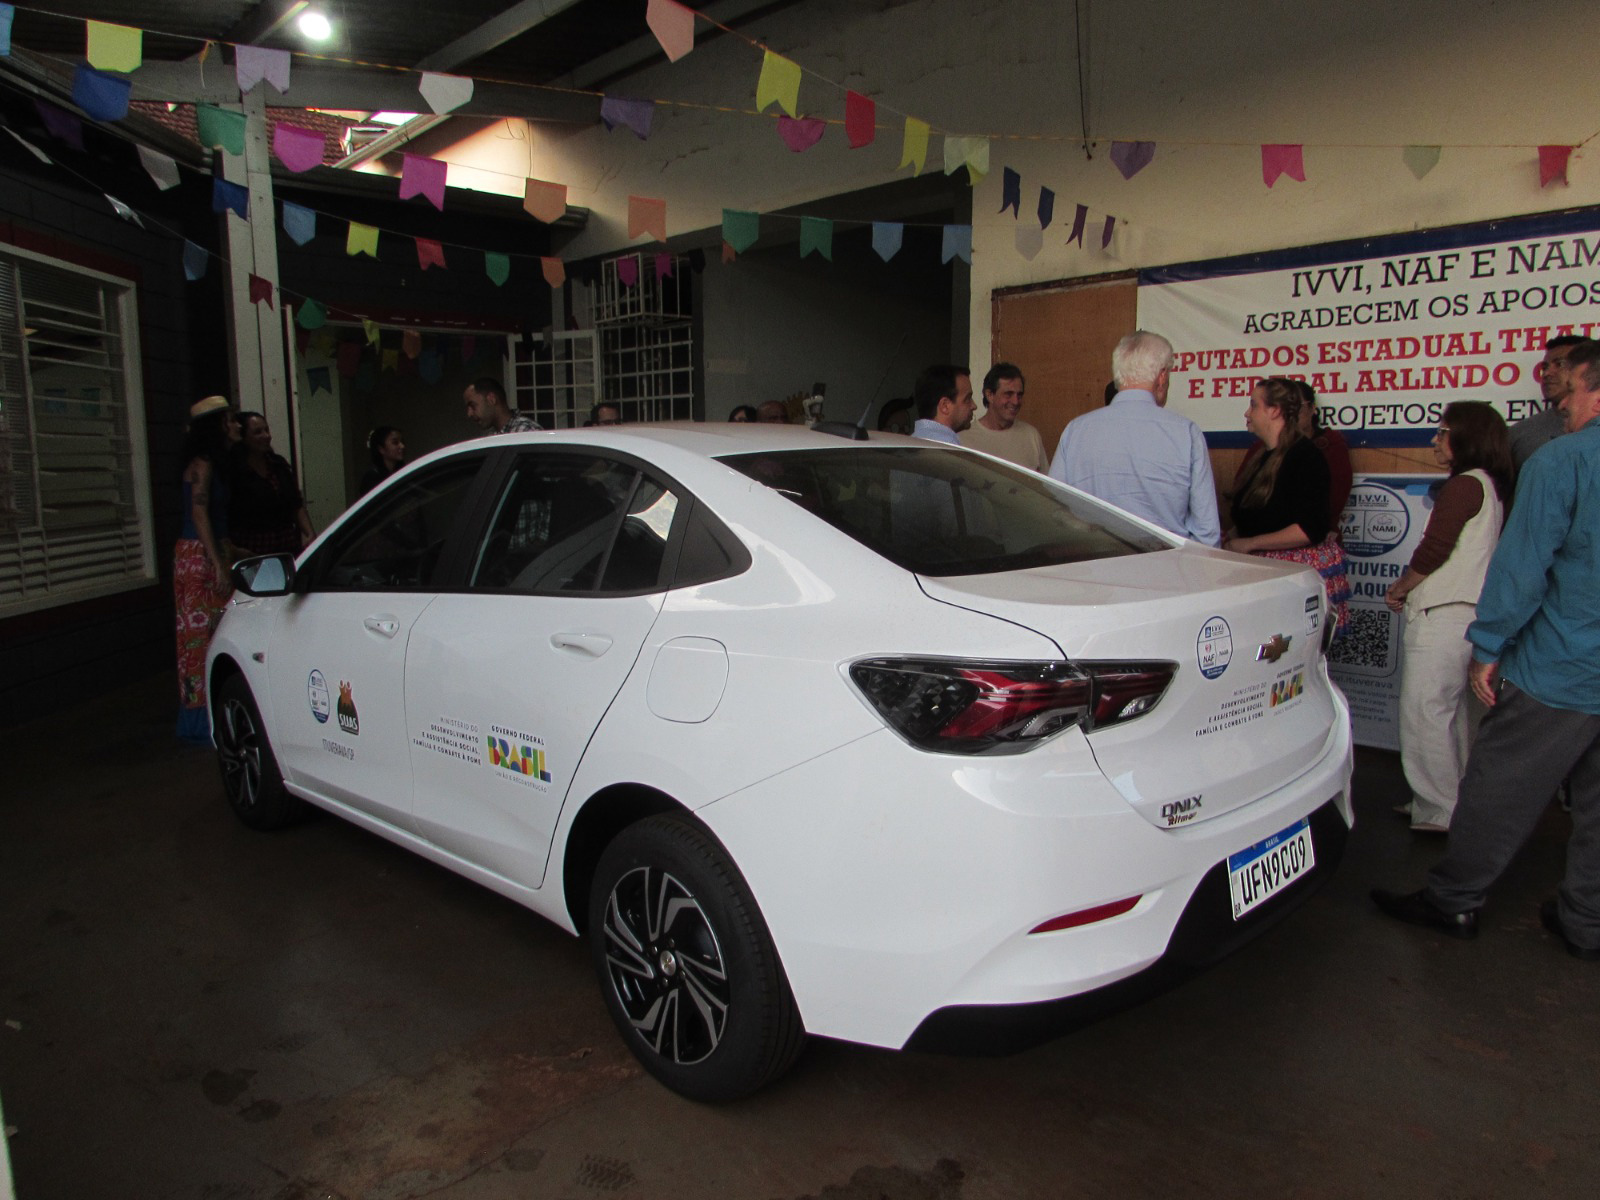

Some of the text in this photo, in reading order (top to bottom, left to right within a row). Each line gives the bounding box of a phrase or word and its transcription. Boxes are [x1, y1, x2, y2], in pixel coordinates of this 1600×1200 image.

[1292, 265, 1371, 298] IVVI,
[1380, 253, 1460, 289] NAF
[1470, 249, 1496, 279] E
[1243, 281, 1600, 334] AGRADECEM OS APOIOS
[1318, 331, 1490, 364] ESTADUAL
[1188, 379, 1204, 398] E
[1355, 362, 1520, 393] ARLINDO
[1372, 525, 1397, 533] NAMI
[338, 713, 358, 731] SUAS
[491, 725, 545, 746] GOVERNO FEDERAL
[487, 735, 551, 783] BRASIL
[1161, 795, 1202, 818] ONIX
[1240, 835, 1306, 905] UFN9C09
